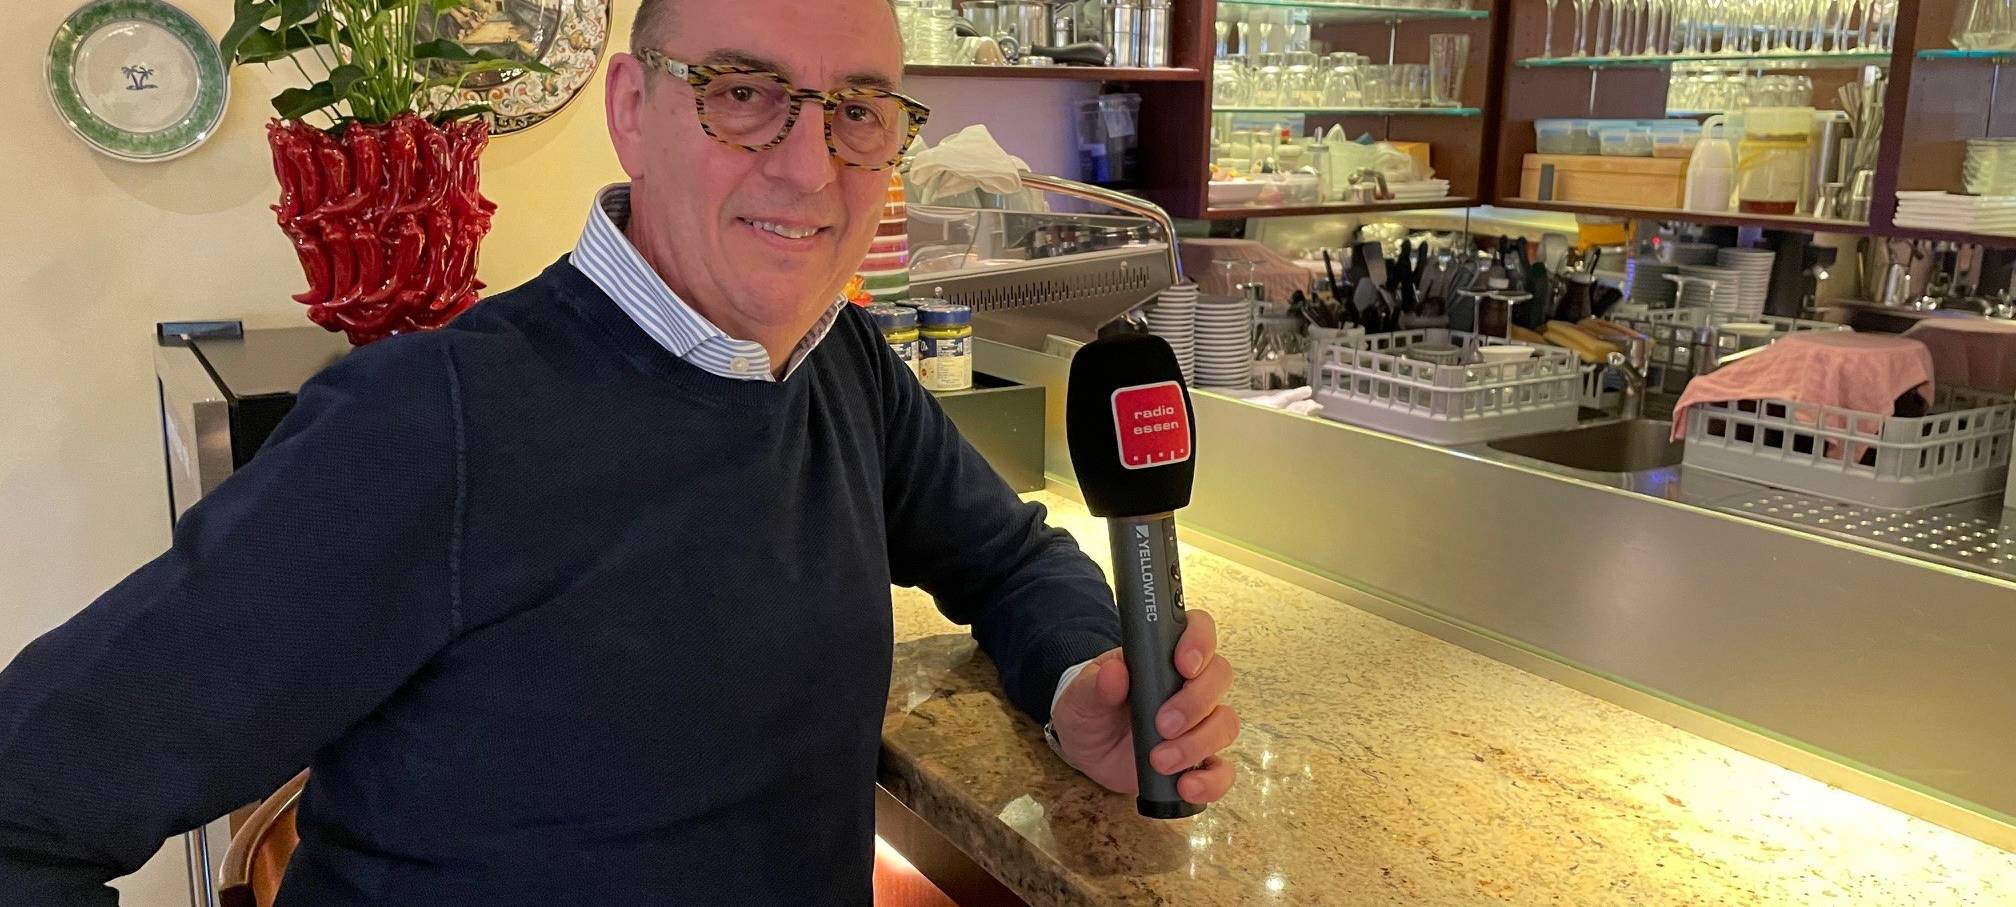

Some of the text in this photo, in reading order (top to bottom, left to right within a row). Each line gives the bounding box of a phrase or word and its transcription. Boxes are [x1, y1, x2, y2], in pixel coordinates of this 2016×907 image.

[1134, 405, 1174, 419] radio
[1133, 421, 1179, 434] essen
[1139, 539, 1158, 622] YELLOWTEC
